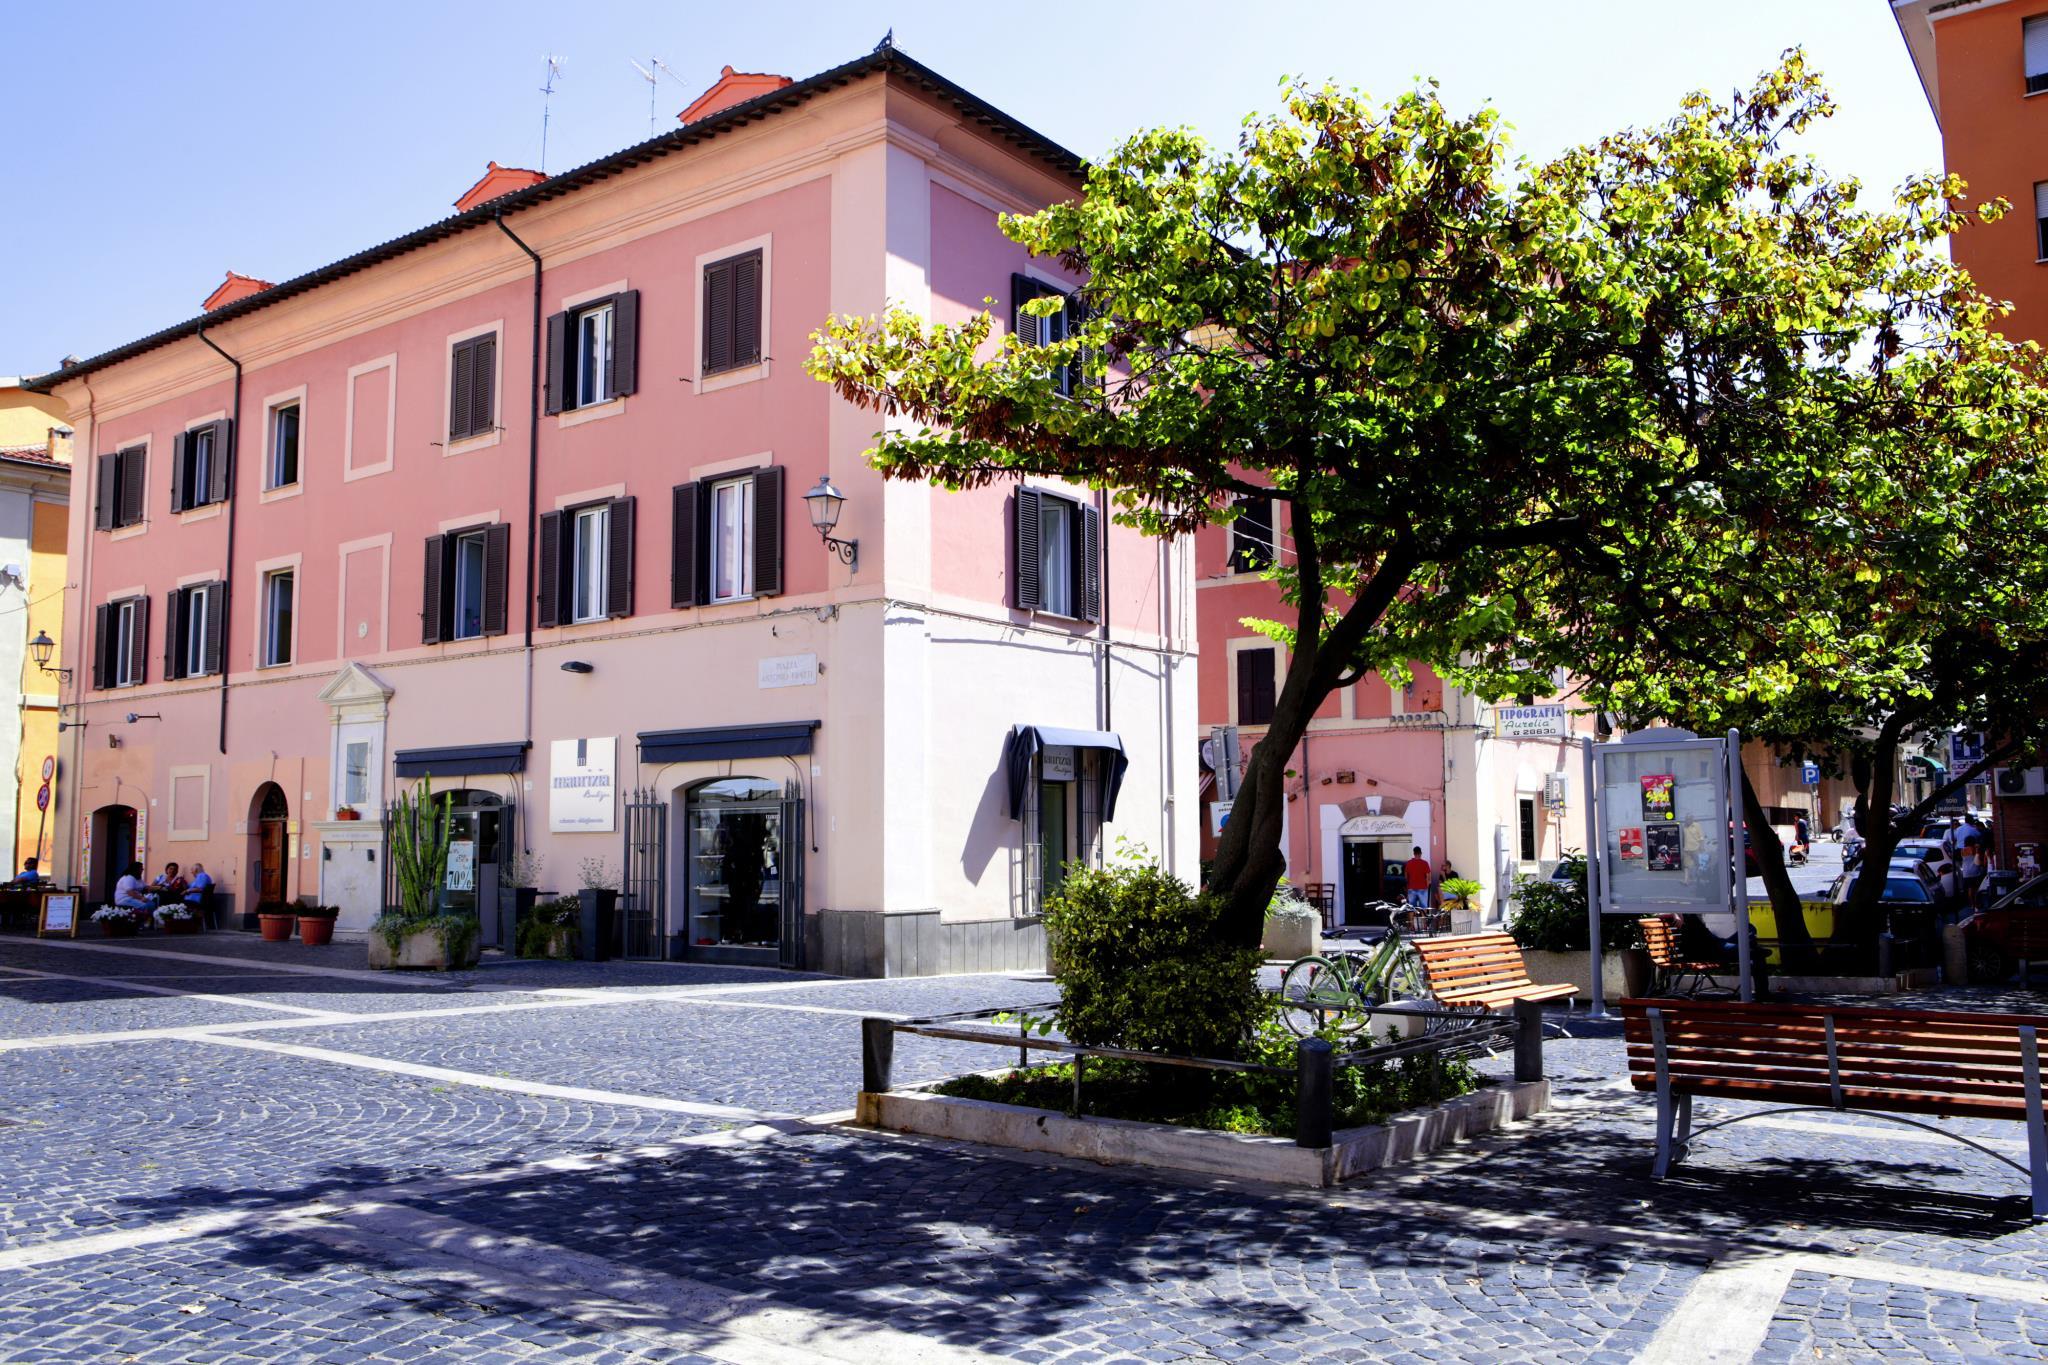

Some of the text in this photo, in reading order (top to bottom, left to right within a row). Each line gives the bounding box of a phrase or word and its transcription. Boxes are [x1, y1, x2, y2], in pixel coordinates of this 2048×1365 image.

[1499, 707, 1562, 720] TIPOGRAFIA
[553, 768, 610, 789] maurizia
[448, 870, 471, 889] 70%
